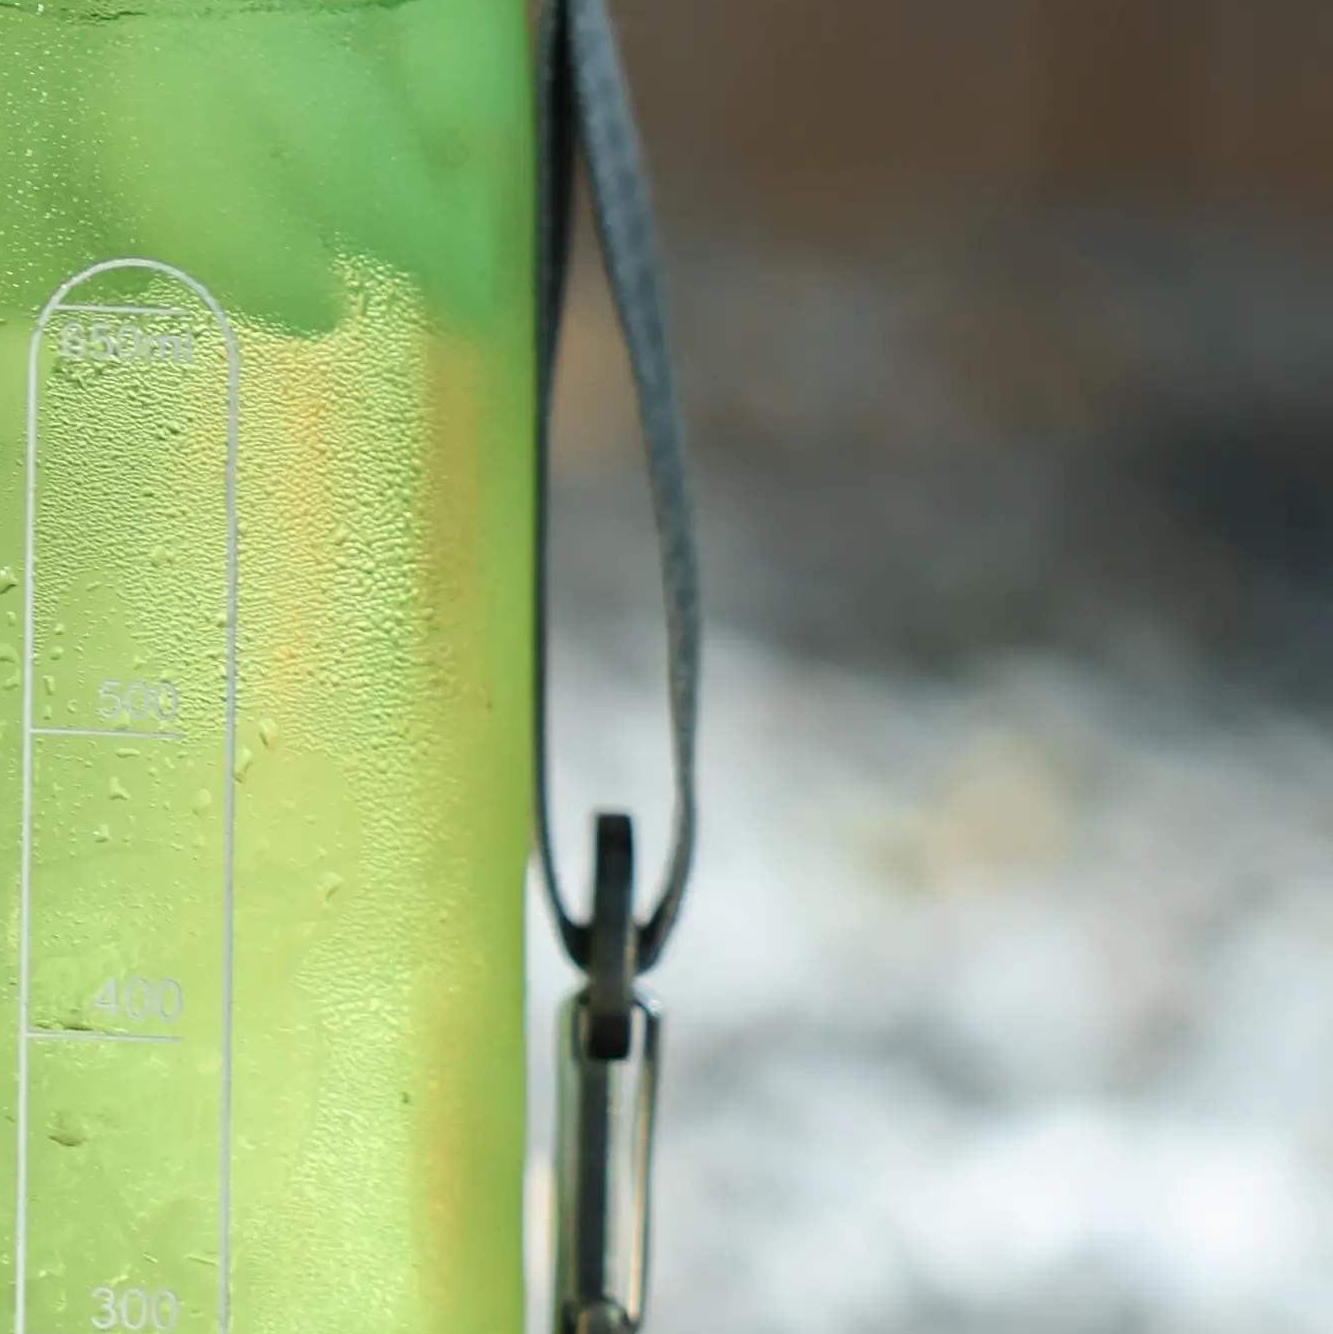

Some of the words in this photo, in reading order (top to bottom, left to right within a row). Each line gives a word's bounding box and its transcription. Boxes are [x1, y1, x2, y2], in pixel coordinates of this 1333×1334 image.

[98, 678, 179, 720] 500
[92, 976, 183, 1023] 400
[90, 1286, 180, 1331] 300
